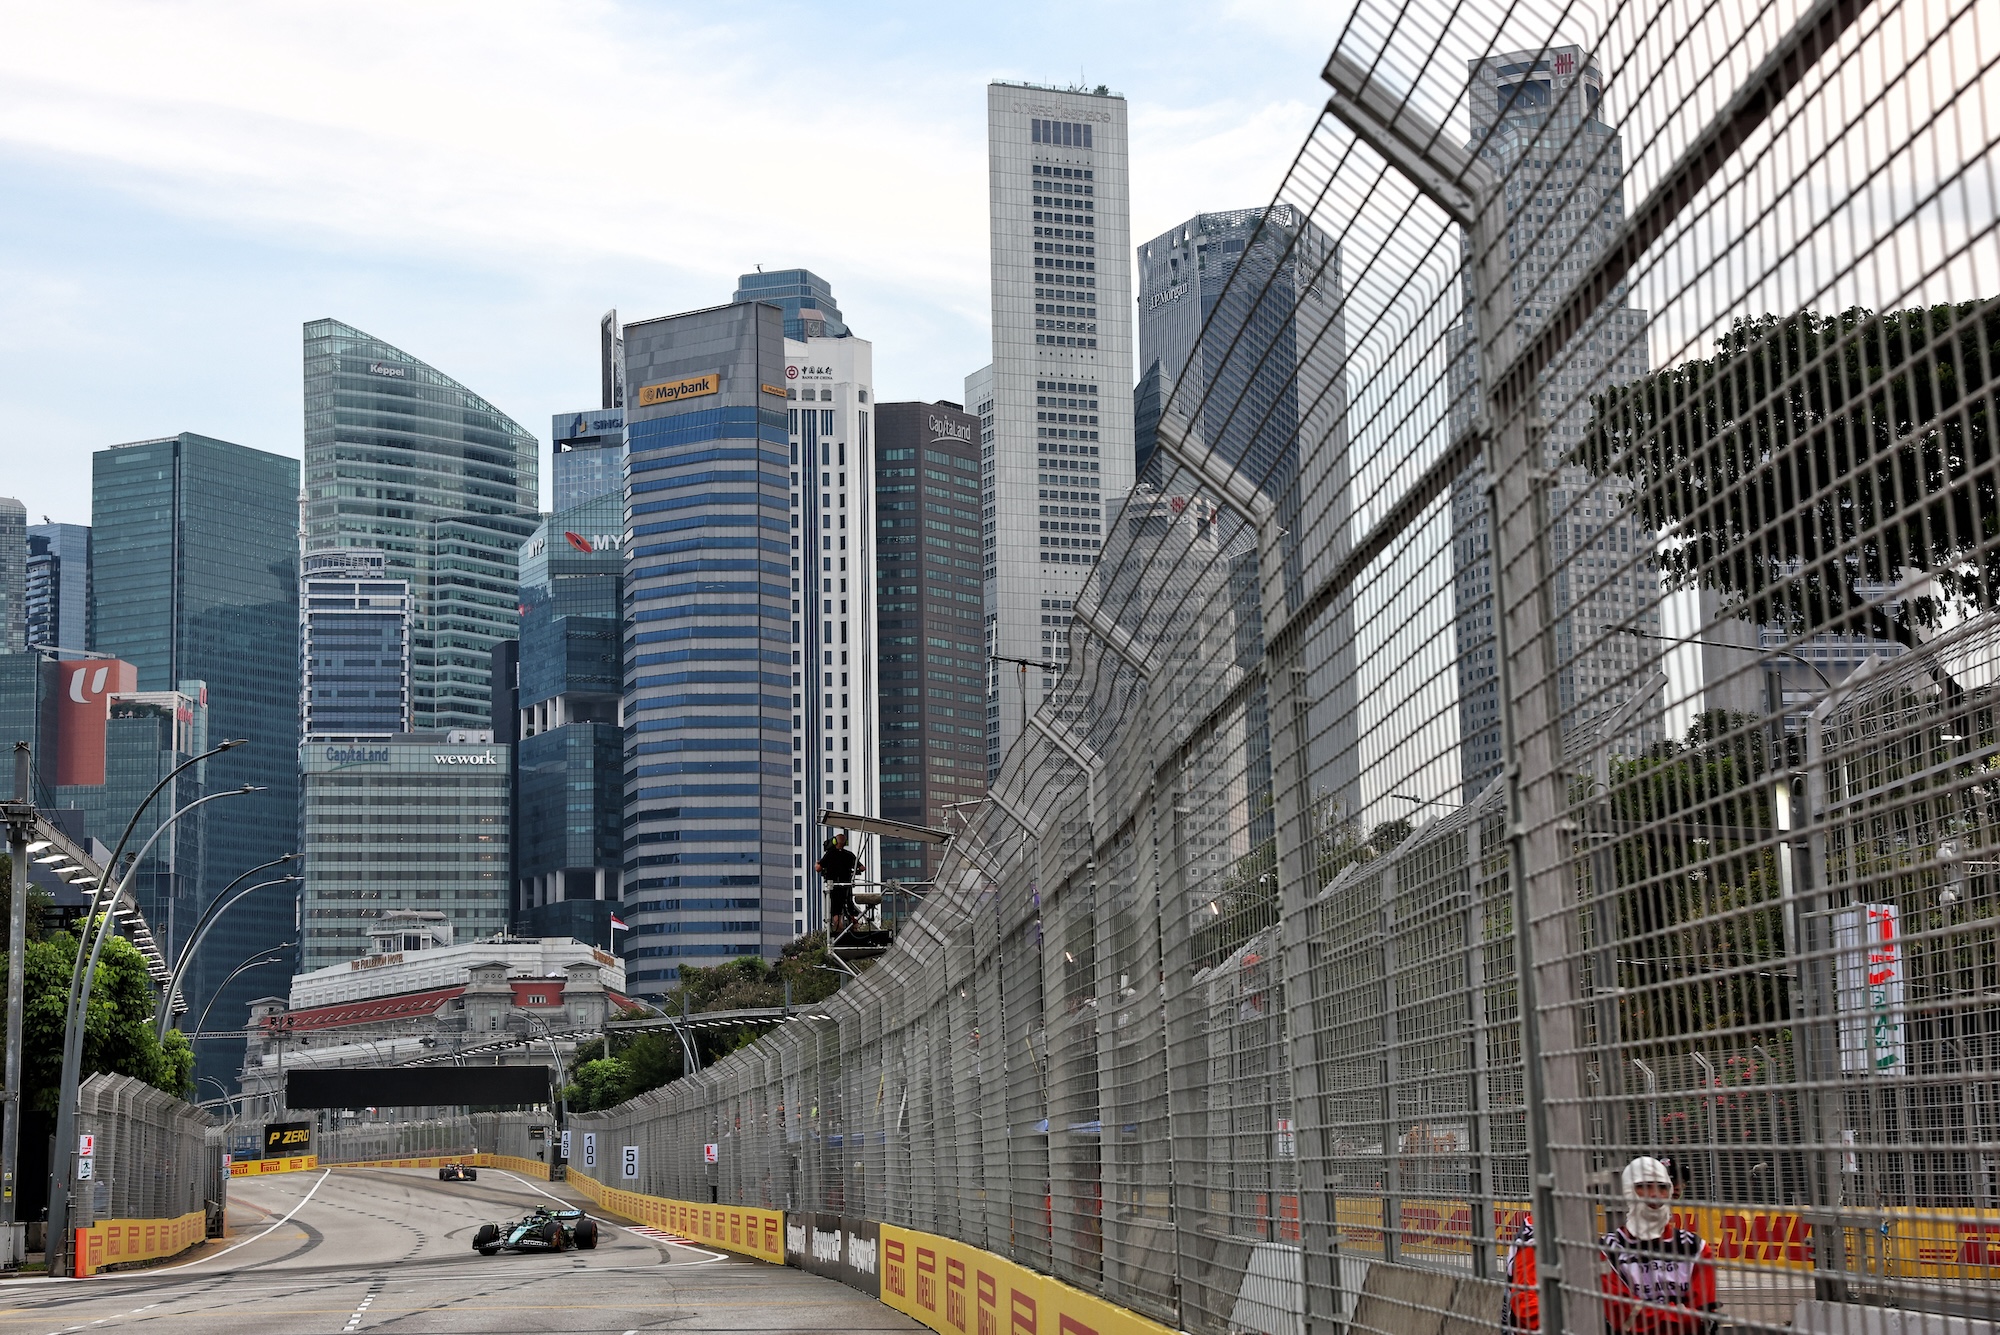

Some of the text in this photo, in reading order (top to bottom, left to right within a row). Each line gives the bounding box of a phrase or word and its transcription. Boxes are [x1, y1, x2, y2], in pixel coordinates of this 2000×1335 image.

[370, 363, 405, 377] Keppel
[655, 378, 710, 399] Maybank
[929, 414, 971, 440] CapitaLand
[326, 745, 388, 765] CapitaLand
[434, 750, 497, 765] wework
[268, 1129, 310, 1145] P ZERO
[260, 1161, 280, 1172] PIRELLI
[626, 1149, 635, 1176] 50
[1718, 1215, 1815, 1262] DHL
[885, 1238, 905, 1298] PIRELLI
[916, 1246, 936, 1313] PIRELLI
[946, 1256, 966, 1334] PIRELLI
